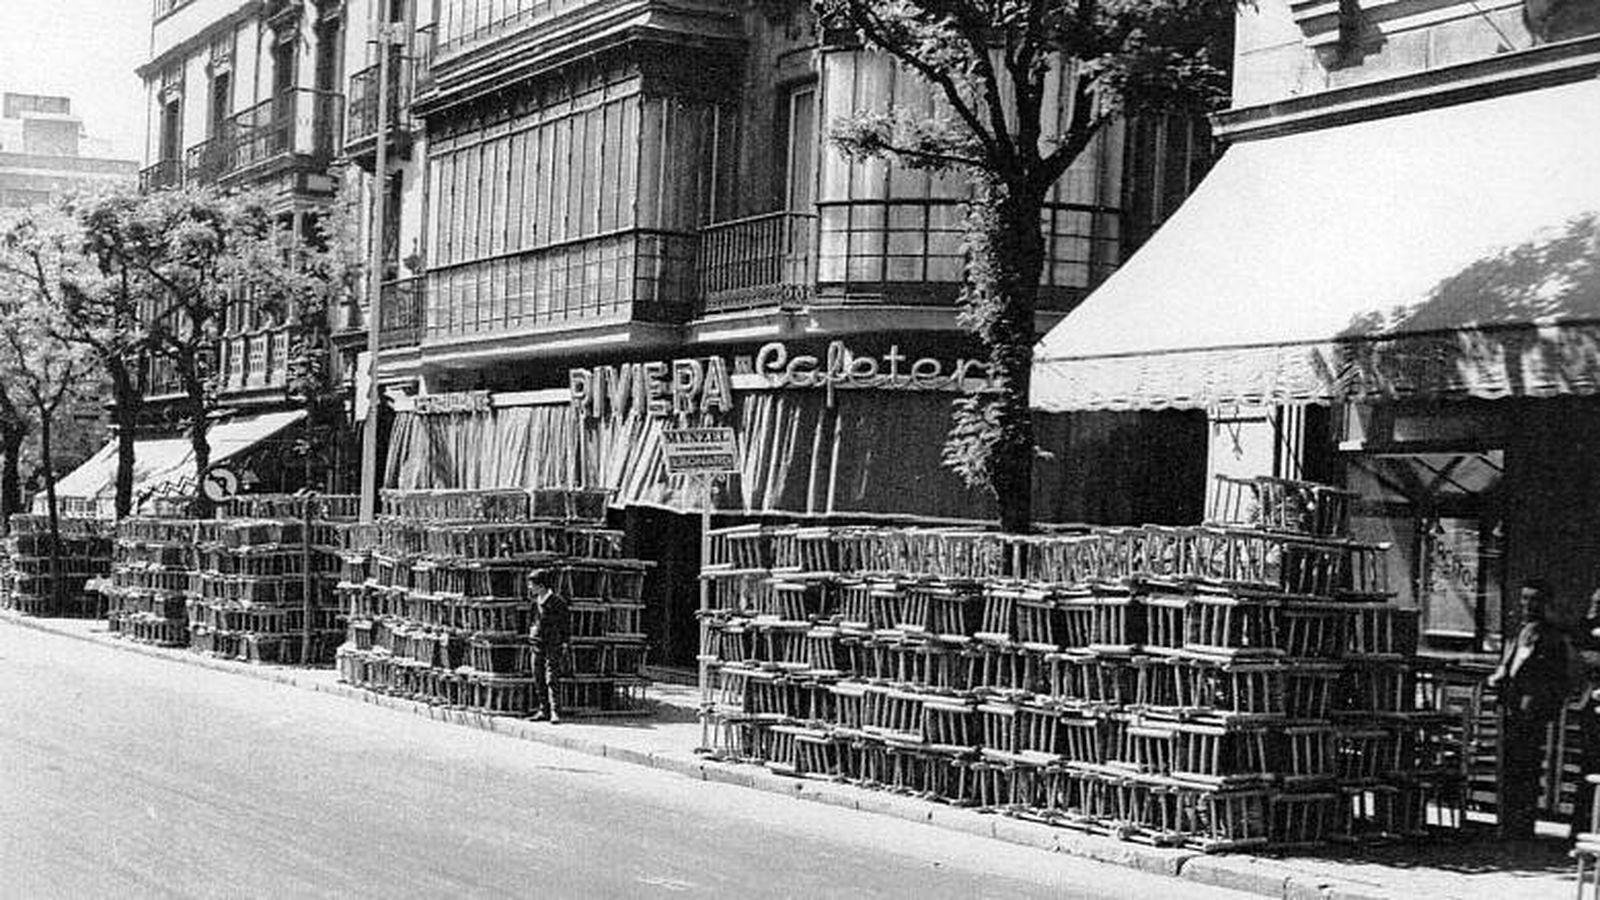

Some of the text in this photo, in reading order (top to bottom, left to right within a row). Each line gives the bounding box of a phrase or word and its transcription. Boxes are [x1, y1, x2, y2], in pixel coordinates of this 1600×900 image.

[569, 341, 994, 418] RIVIERA Cafeter
[663, 430, 731, 443] MENZEL
